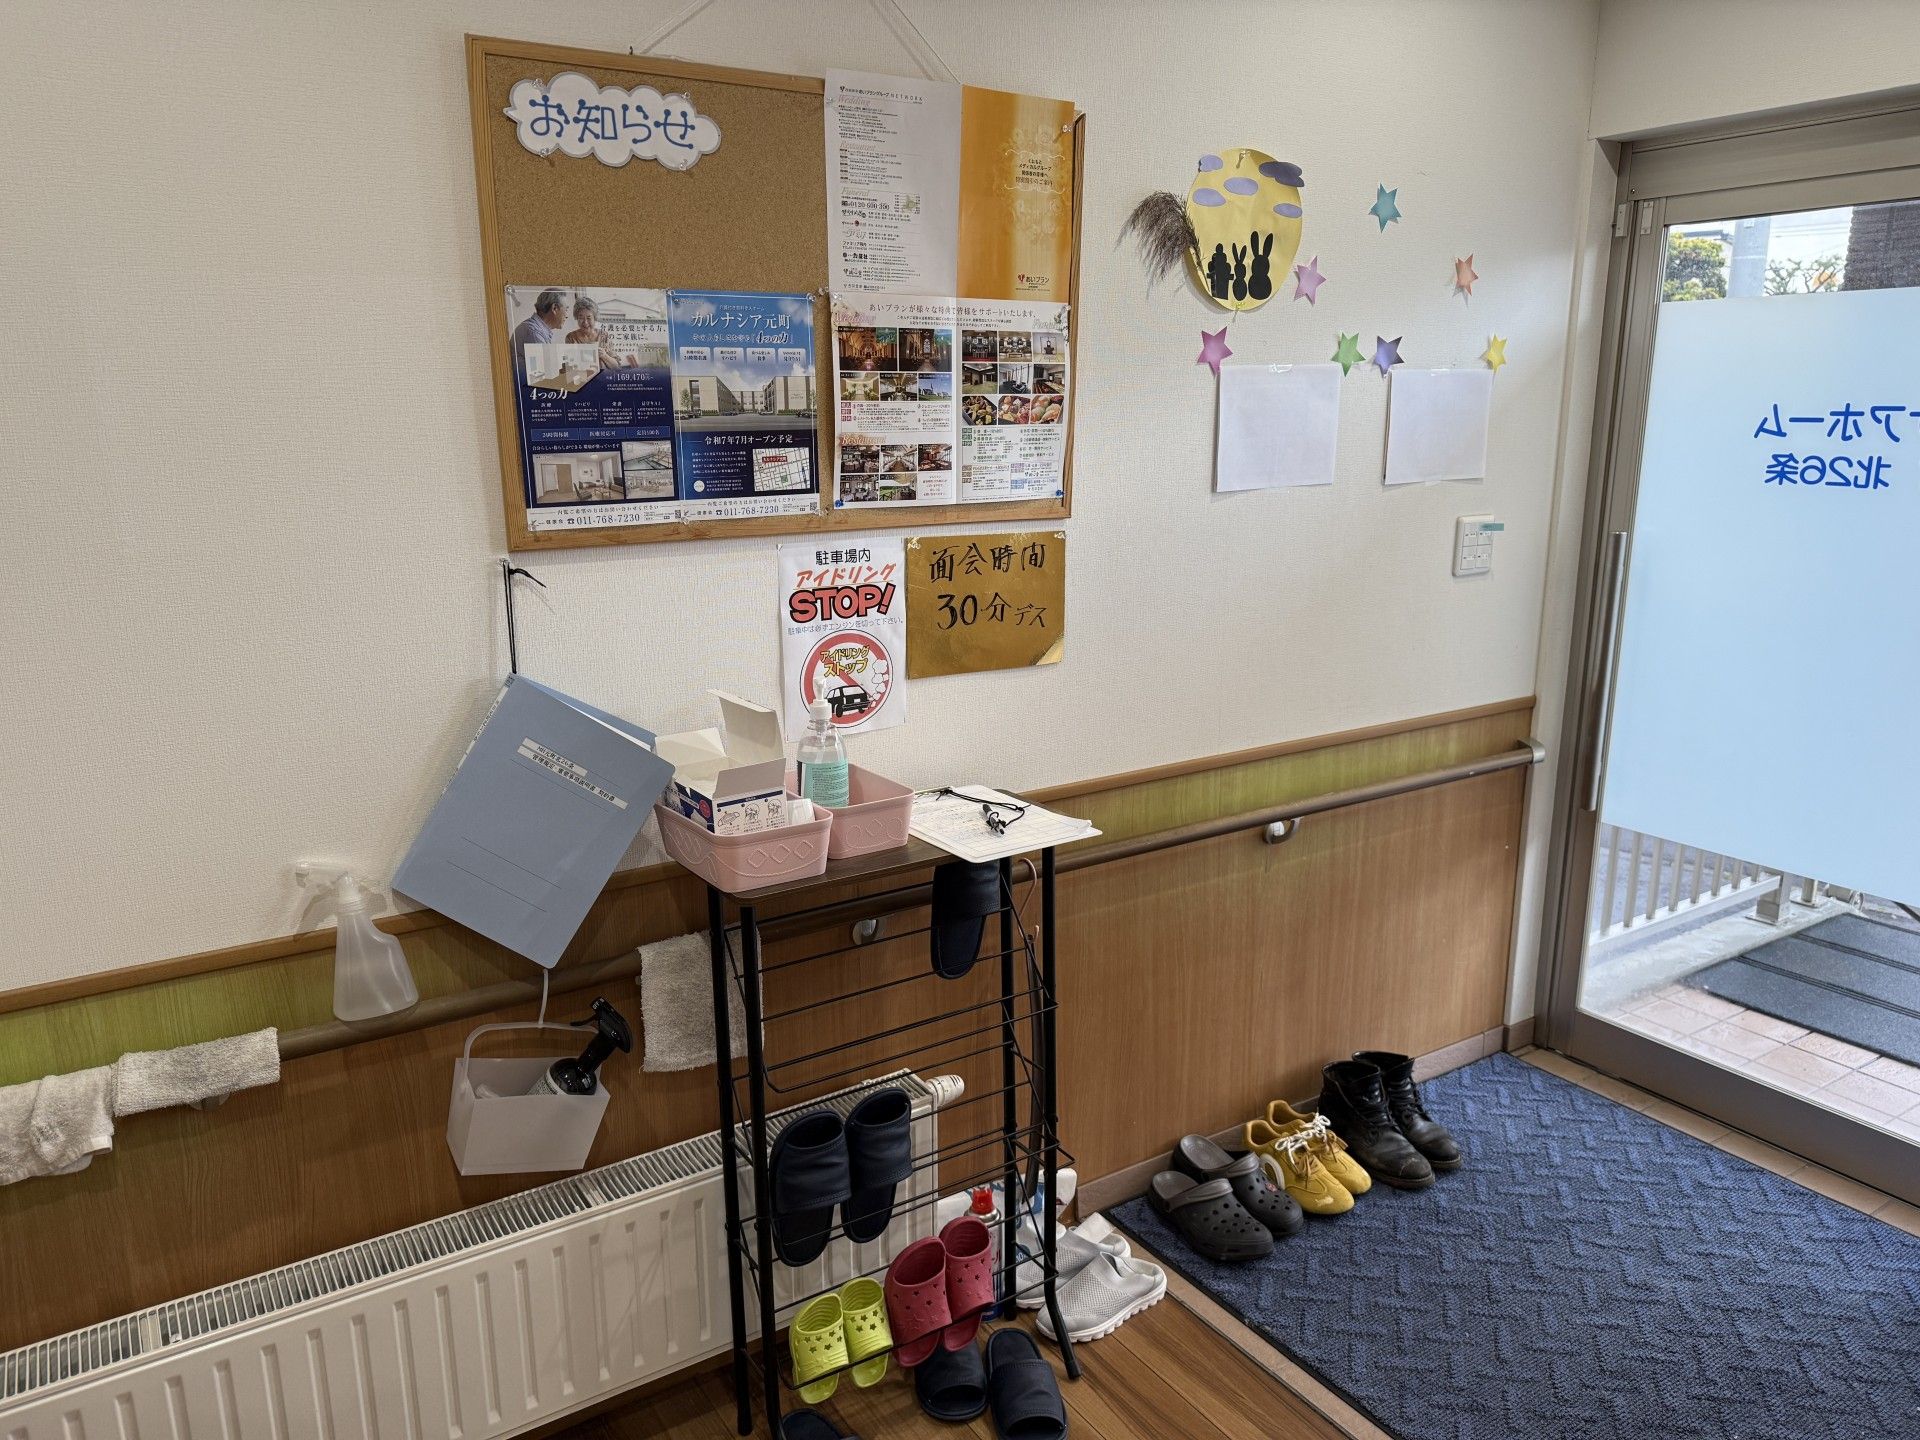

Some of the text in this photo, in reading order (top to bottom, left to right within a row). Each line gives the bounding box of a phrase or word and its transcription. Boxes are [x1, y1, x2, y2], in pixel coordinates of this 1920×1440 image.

[529, 95, 696, 149] お知らせ
[692, 312, 790, 330] カルナシア元町
[530, 388, 568, 400] 4つの力
[704, 434, 793, 445] 令和7年7月オープン予定
[576, 514, 640, 525] 011-768-7230
[724, 505, 779, 516] 011-768-7230
[816, 548, 871, 566] 駐車場内
[930, 542, 1046, 583] 面会時間
[796, 563, 896, 588] アイドリング
[789, 582, 896, 624] STOP!
[820, 645, 870, 664] アイドリング
[824, 658, 868, 678] ストップ
